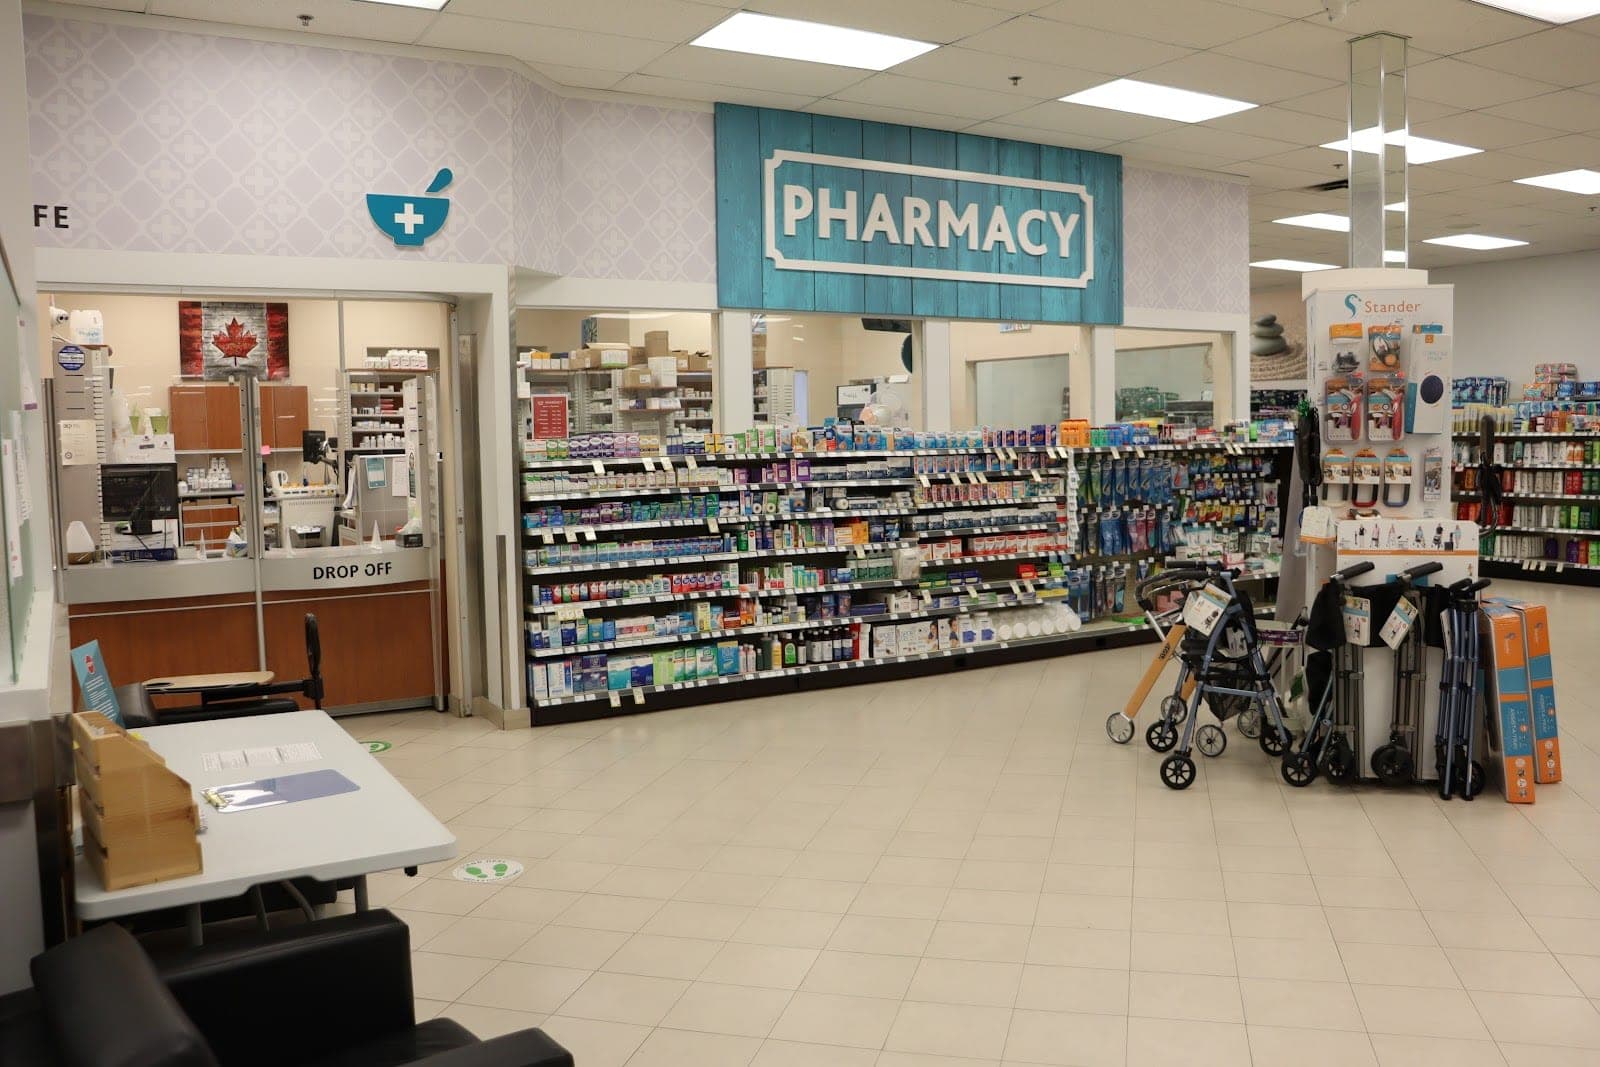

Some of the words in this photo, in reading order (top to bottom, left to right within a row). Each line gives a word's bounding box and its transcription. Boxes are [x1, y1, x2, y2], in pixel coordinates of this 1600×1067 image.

[34, 204, 69, 229] FE
[783, 184, 1080, 259] PHARMACY
[1365, 300, 1421, 313] Stander
[313, 564, 359, 580] DROP
[364, 561, 392, 577] OFF
